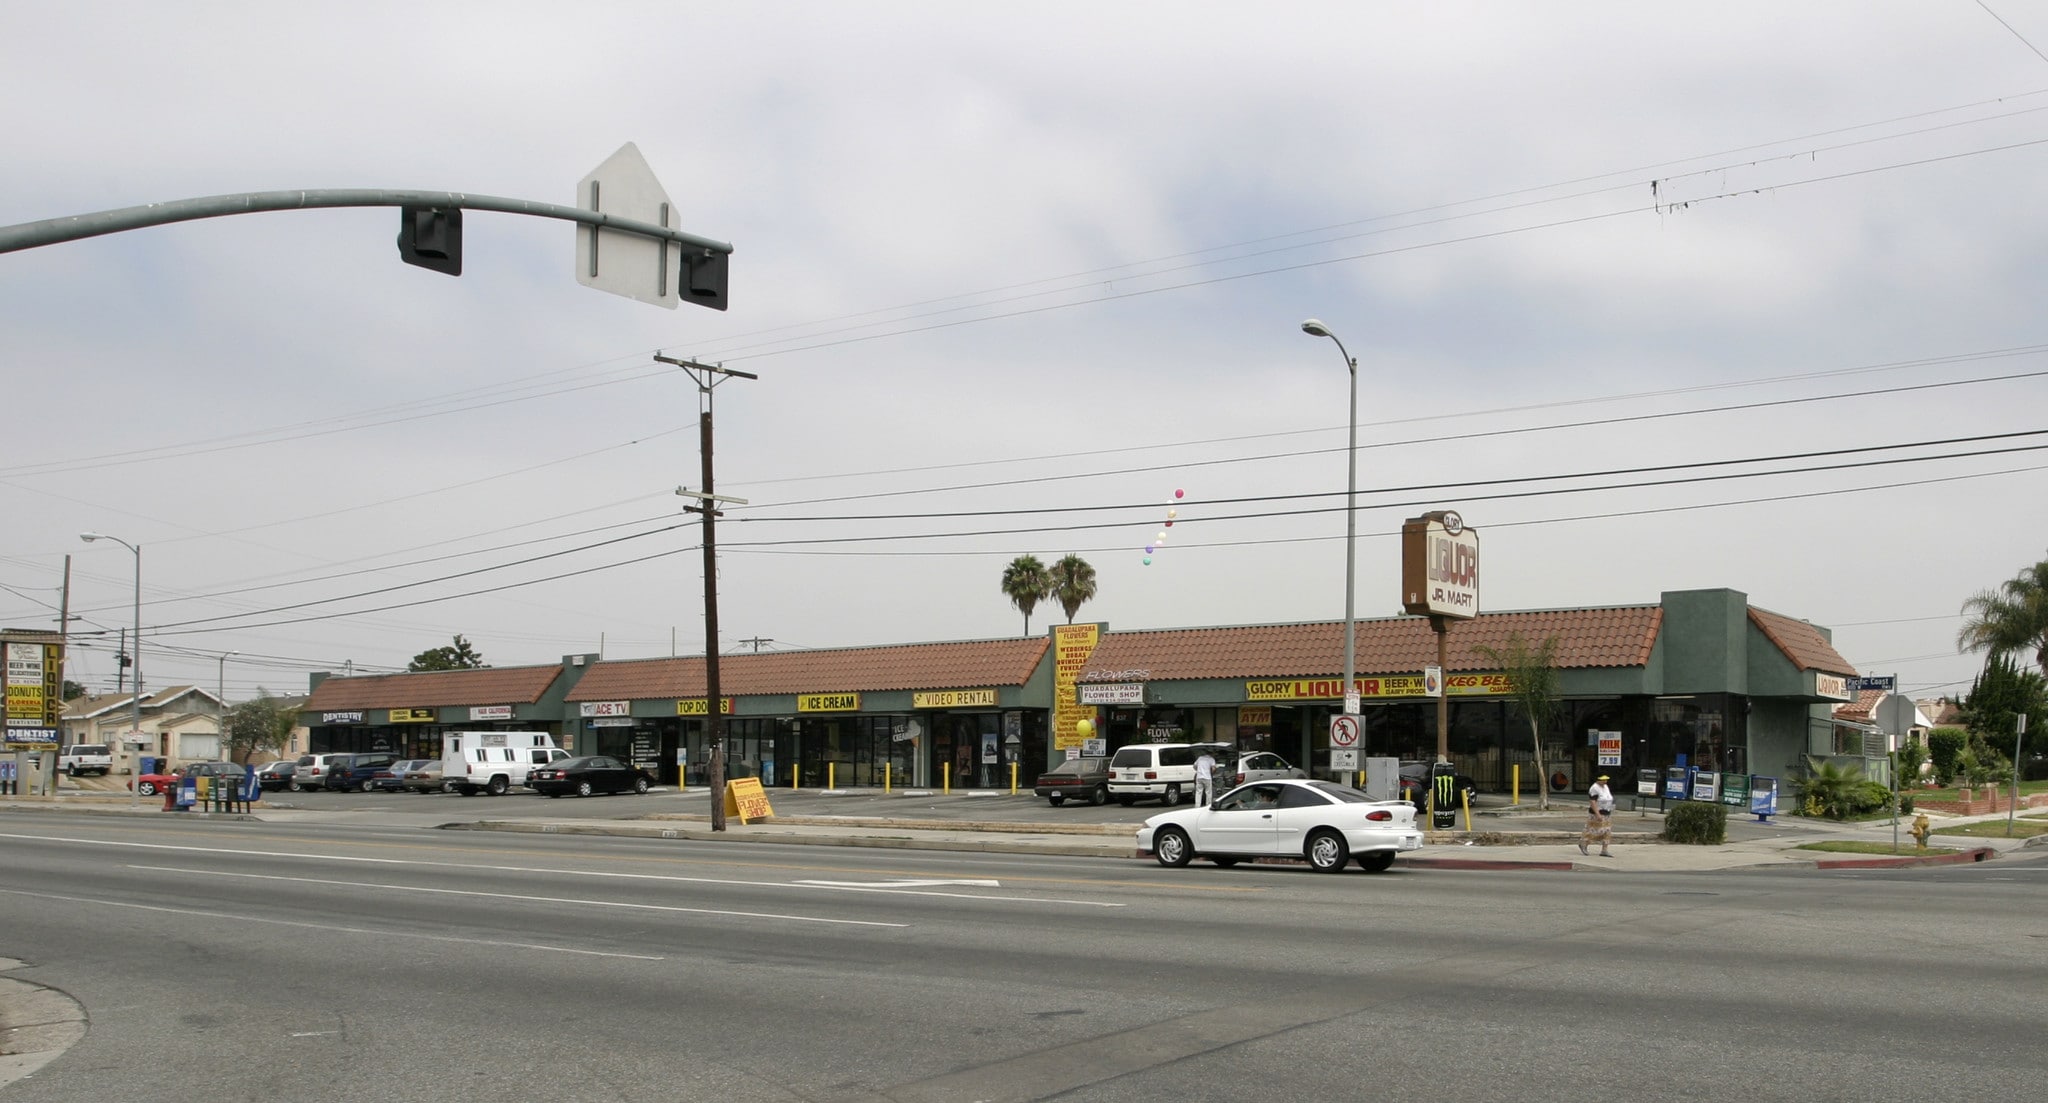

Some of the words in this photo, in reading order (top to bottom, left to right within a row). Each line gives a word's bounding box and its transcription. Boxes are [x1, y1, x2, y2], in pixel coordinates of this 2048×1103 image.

[1428, 536, 1476, 589] LIQUOR
[1432, 588, 1445, 602] JR.
[1447, 590, 1473, 607] MART
[1086, 669, 1151, 680] FLOWERS
[1250, 682, 1291, 695] GLORY
[1384, 679, 1410, 688] BEER
[1446, 676, 1478, 688] KEG
[1818, 676, 1841, 695] LIQUOR
[1847, 679, 1868, 687] Pacific
[8, 686, 42, 698] DONUTS
[808, 697, 821, 709] ICE
[823, 695, 855, 709] CREAM
[925, 693, 953, 705] VIDEO
[957, 692, 993, 705] RENTAL
[595, 703, 612, 715] ACE
[615, 703, 627, 714] TV
[679, 701, 694, 712] TOP
[695, 700, 728, 712] DOS
[323, 711, 363, 723] DENTISTRY
[1241, 712, 1270, 723] ATM
[7, 728, 56, 738] DENTIST
[1600, 739, 1620, 749] MILK
